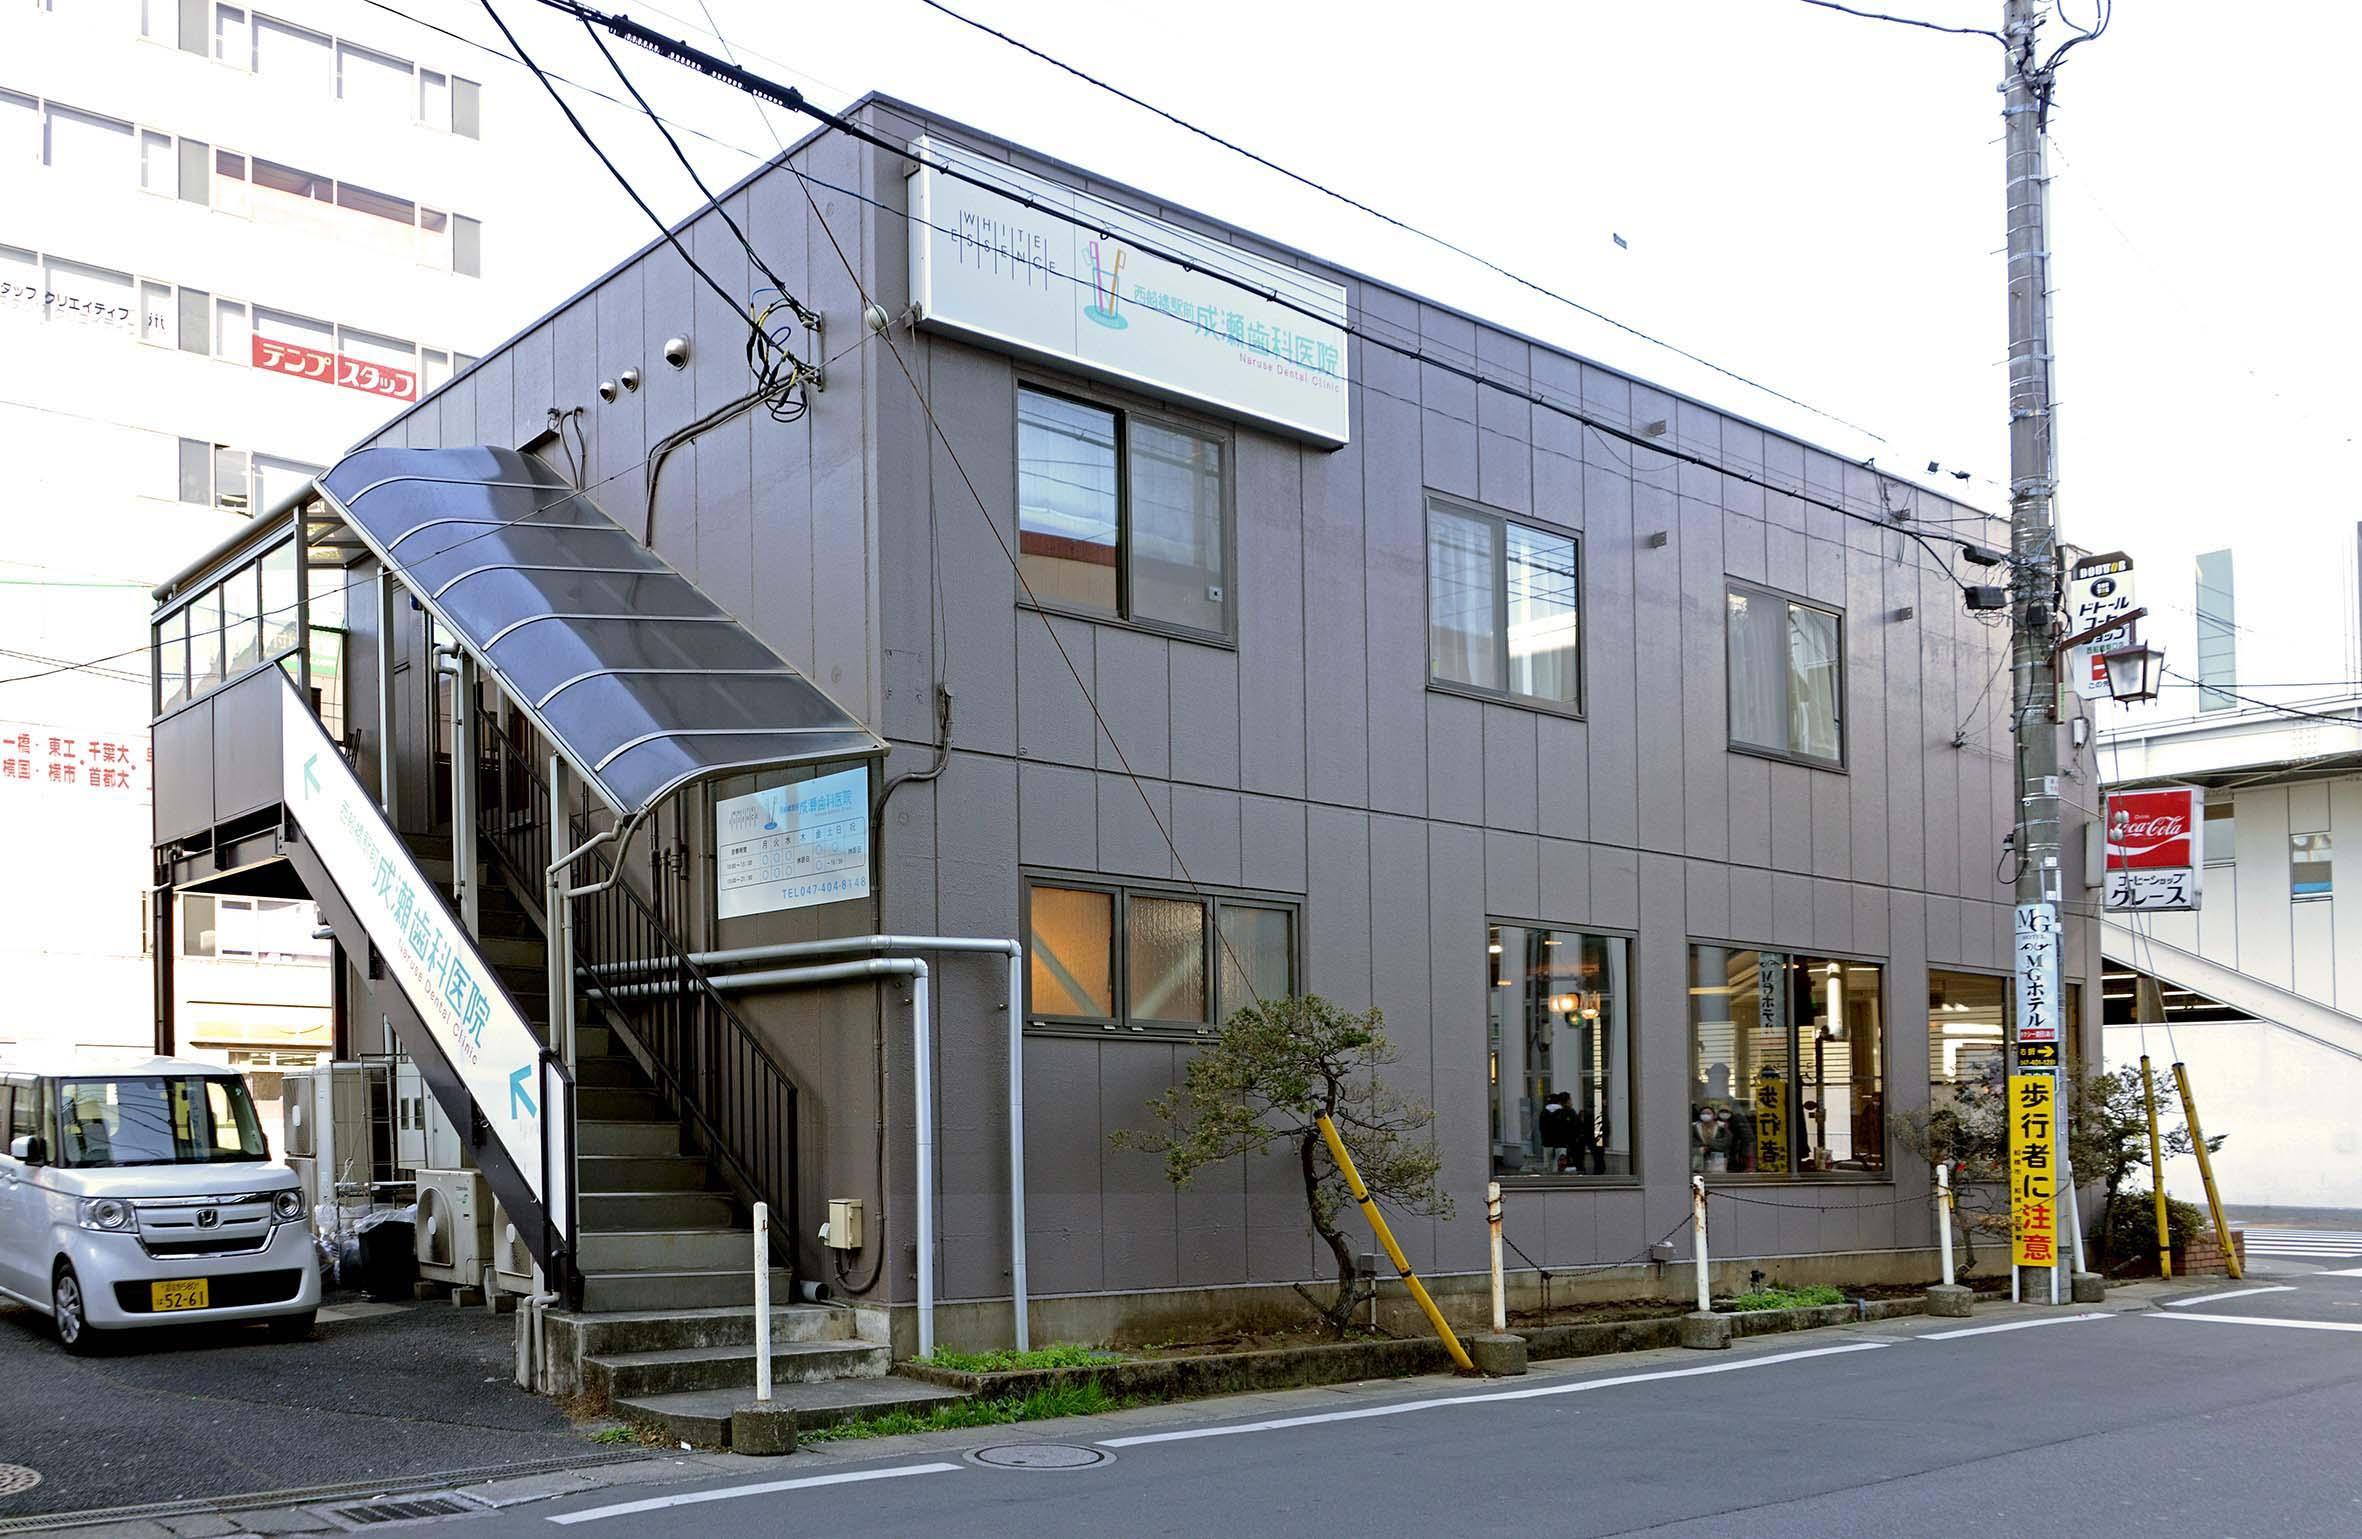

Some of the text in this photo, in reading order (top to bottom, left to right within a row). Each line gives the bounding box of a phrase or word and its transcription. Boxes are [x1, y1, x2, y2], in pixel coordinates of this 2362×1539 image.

[963, 210, 1041, 249] WHITE
[951, 228, 1056, 274] ESSENCE
[1239, 352, 1340, 393] Naruse Dental Clinic
[2080, 597, 2130, 616] ドトール
[2111, 886, 2187, 907] グレース
[2118, 873, 2187, 887] コーヒーショップ
[2018, 908, 2052, 933] MG
[424, 978, 452, 1026] Dental
[452, 1022, 479, 1067] Clinic
[2020, 1082, 2052, 1261] 歩行者に注意
